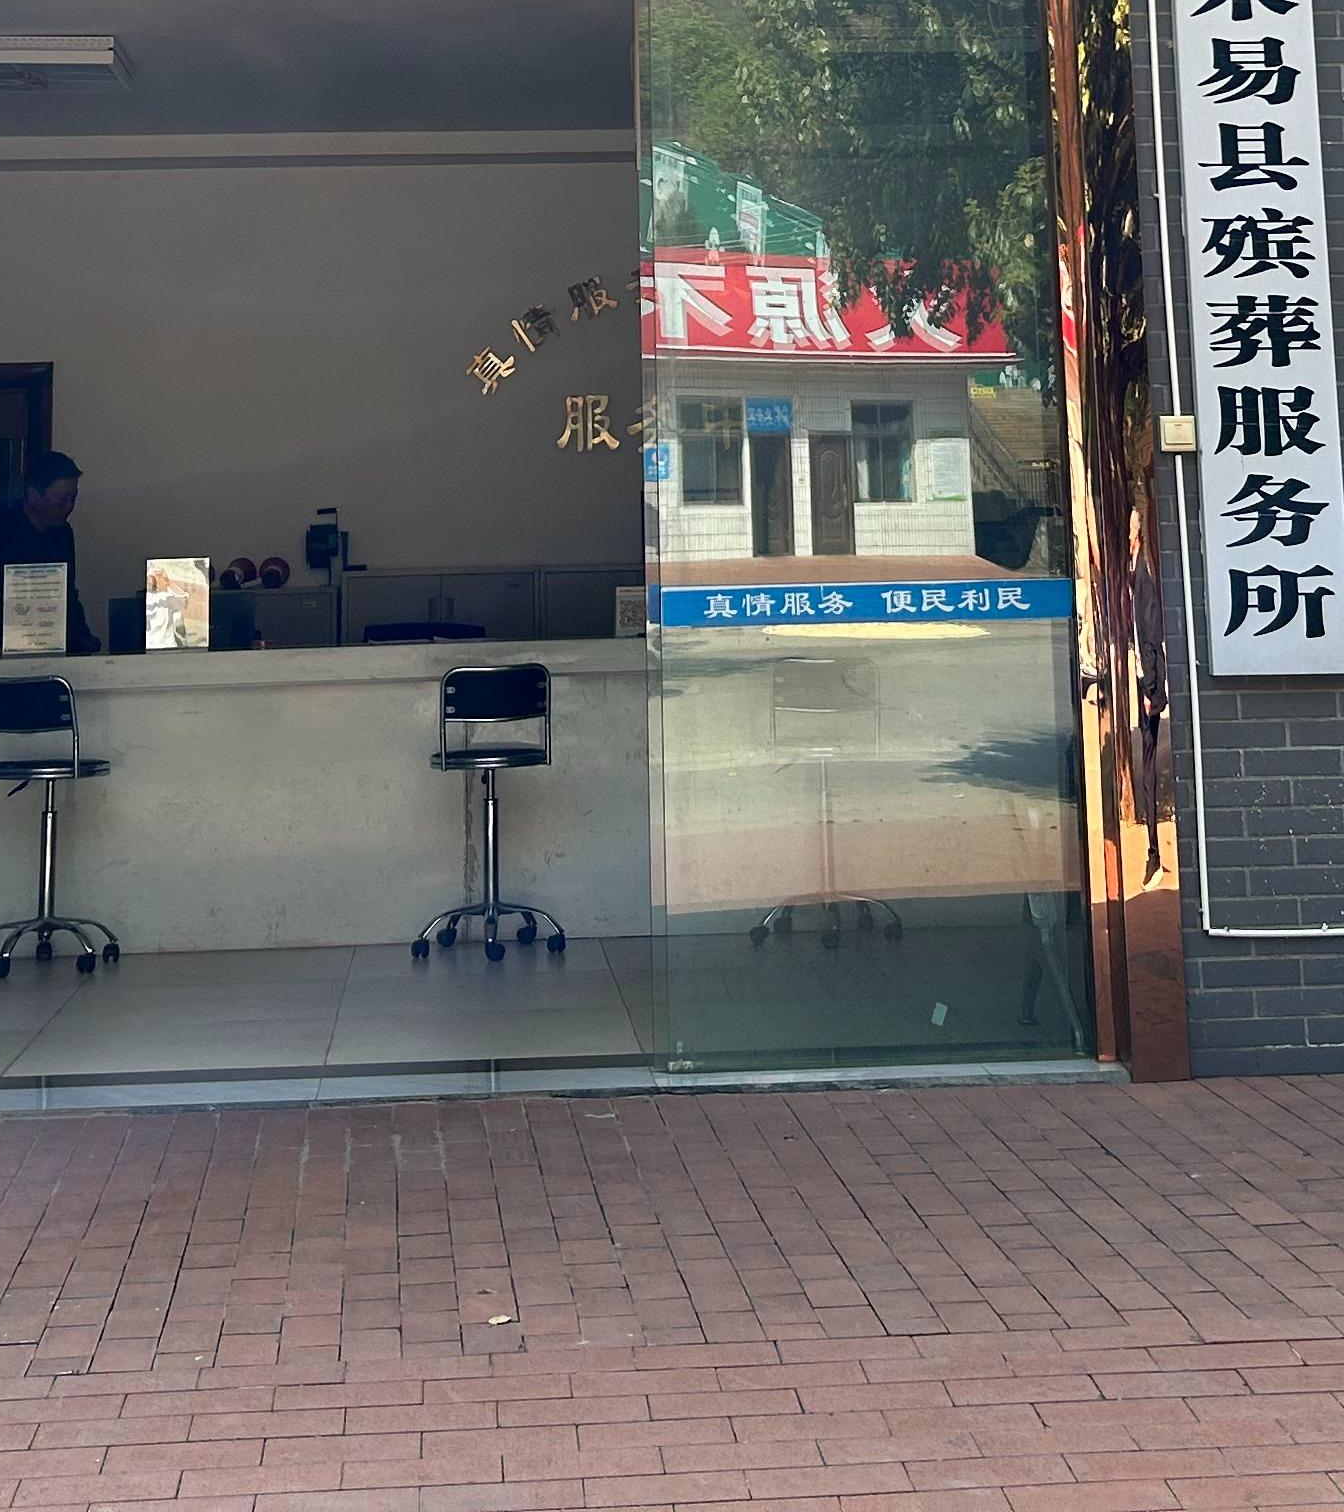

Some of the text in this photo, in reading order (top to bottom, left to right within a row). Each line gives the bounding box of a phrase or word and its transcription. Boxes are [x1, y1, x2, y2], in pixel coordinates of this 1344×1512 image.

[703, 586, 1031, 618] 真情服务 便民利民
